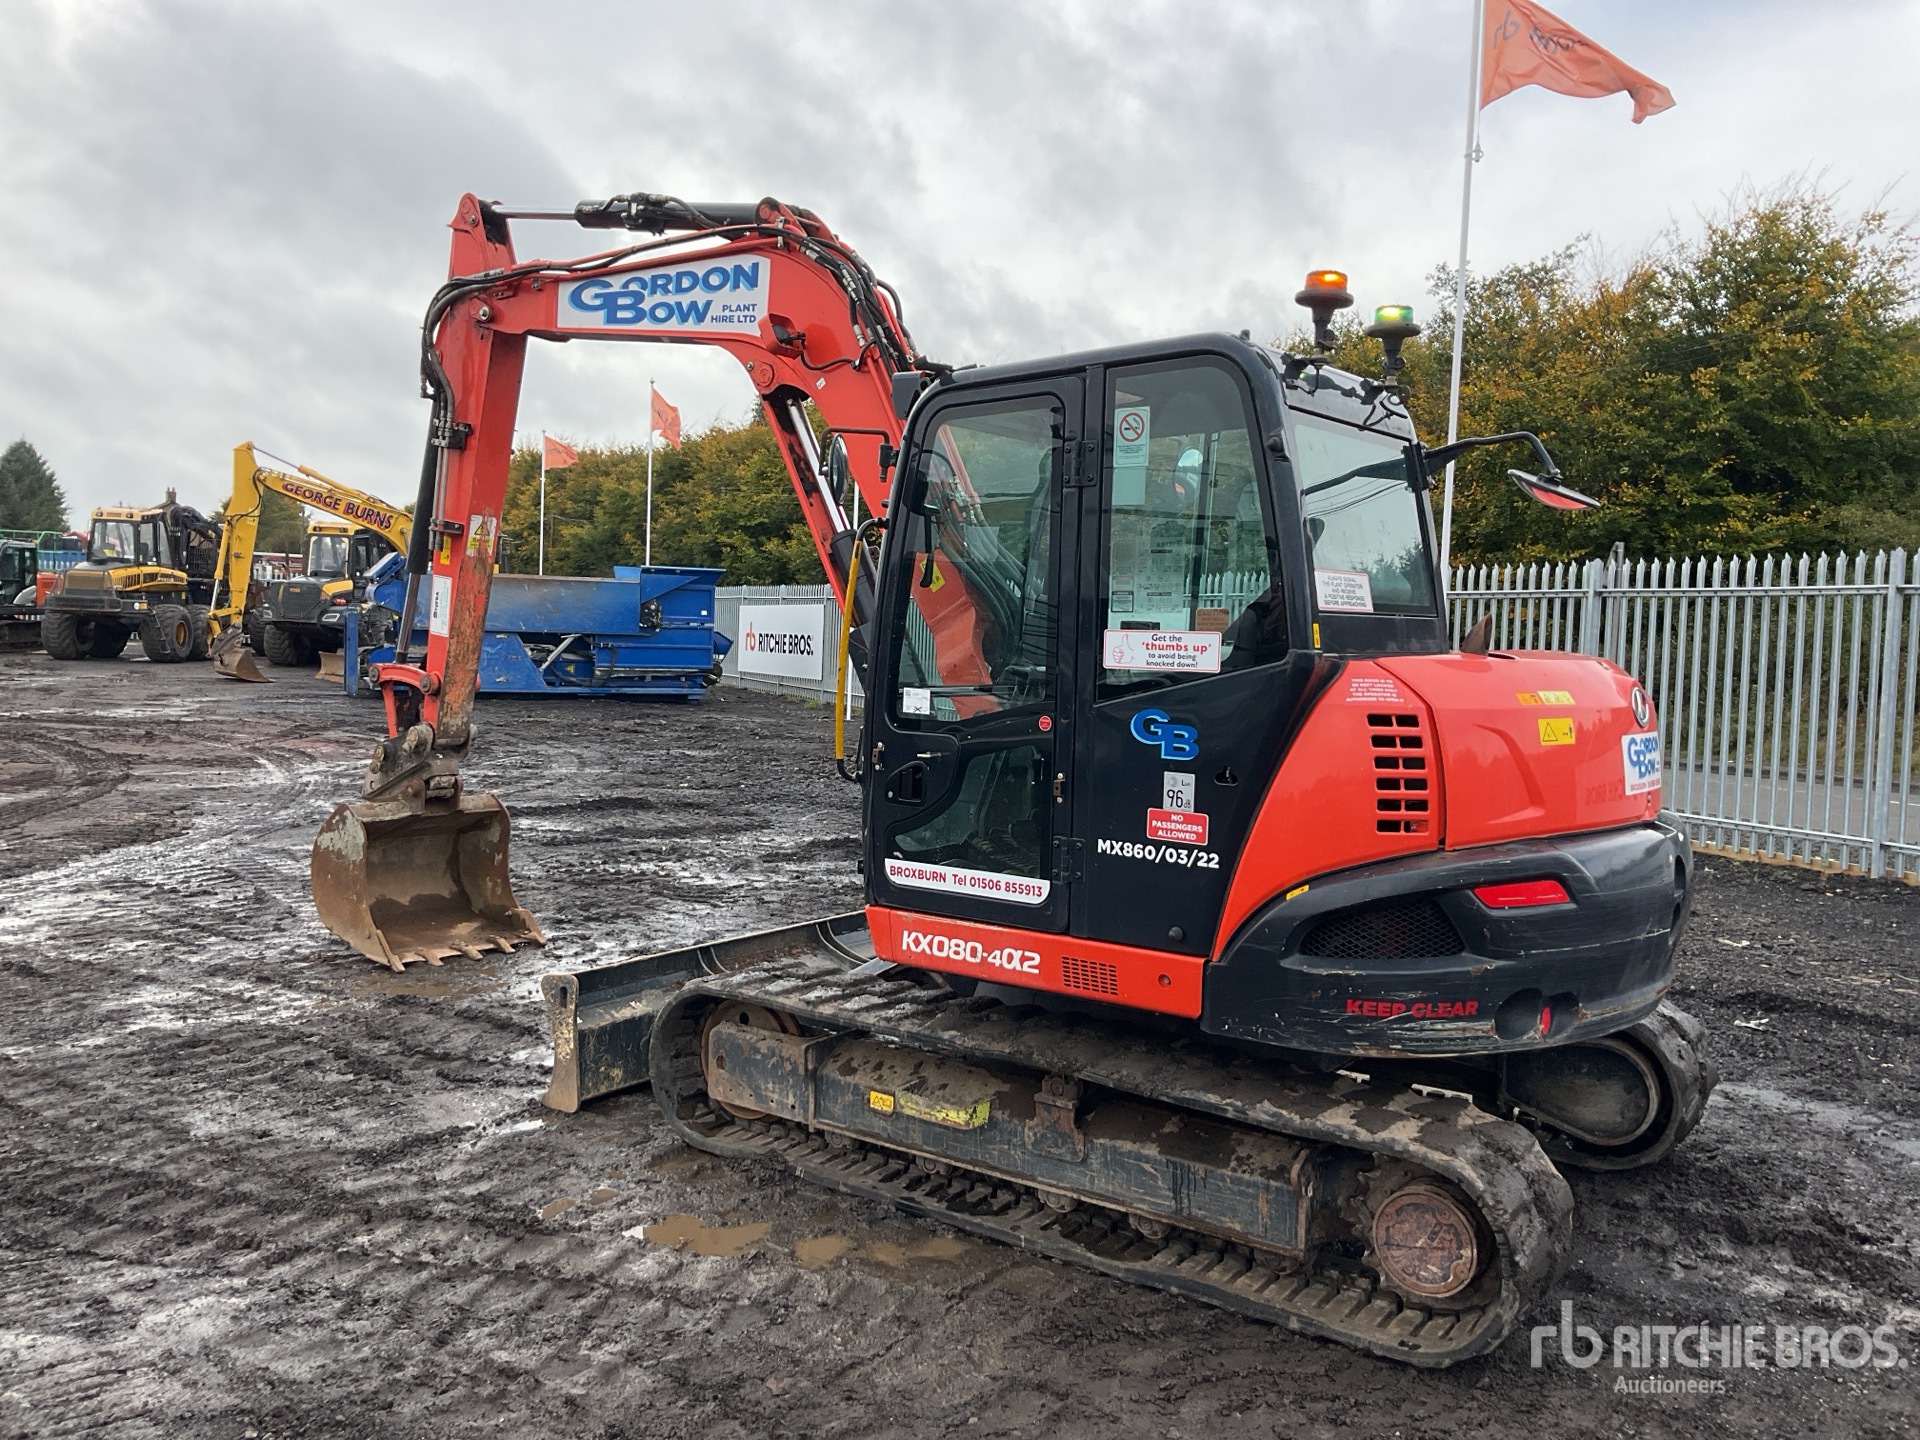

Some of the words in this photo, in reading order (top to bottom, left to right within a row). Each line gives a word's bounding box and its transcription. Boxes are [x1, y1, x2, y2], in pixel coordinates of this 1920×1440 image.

[568, 262, 759, 313] GORDON
[594, 290, 713, 325] BOW
[722, 303, 758, 313] PLANT
[710, 314, 735, 324] HIRE
[737, 314, 757, 324] LTD
[282, 483, 342, 511] GEORGE
[343, 502, 394, 531] BURNS
[758, 632, 787, 654] RITCHIE
[1151, 633, 1167, 642] Get
[1169, 634, 1182, 642] the
[1146, 660, 1175, 668] knocked
[1176, 661, 1198, 669] down!
[1157, 652, 1176, 660] avoid
[1177, 652, 1197, 662] being
[1130, 709, 1200, 761] GB
[1167, 789, 1184, 808] 96
[1184, 799, 1192, 809] dB
[1152, 820, 1203, 833] PASSENGERS
[1171, 814, 1184, 822] NO
[1157, 829, 1197, 841] ALLOWED
[1097, 838, 1220, 869] MX860/03/22
[889, 865, 947, 884] BROXBURN
[952, 873, 967, 887] Tel
[969, 876, 1002, 892] 01506
[1004, 881, 1043, 898] 855913
[1346, 999, 1405, 1018] KEEP
[1410, 1000, 1479, 1019] CLEAR
